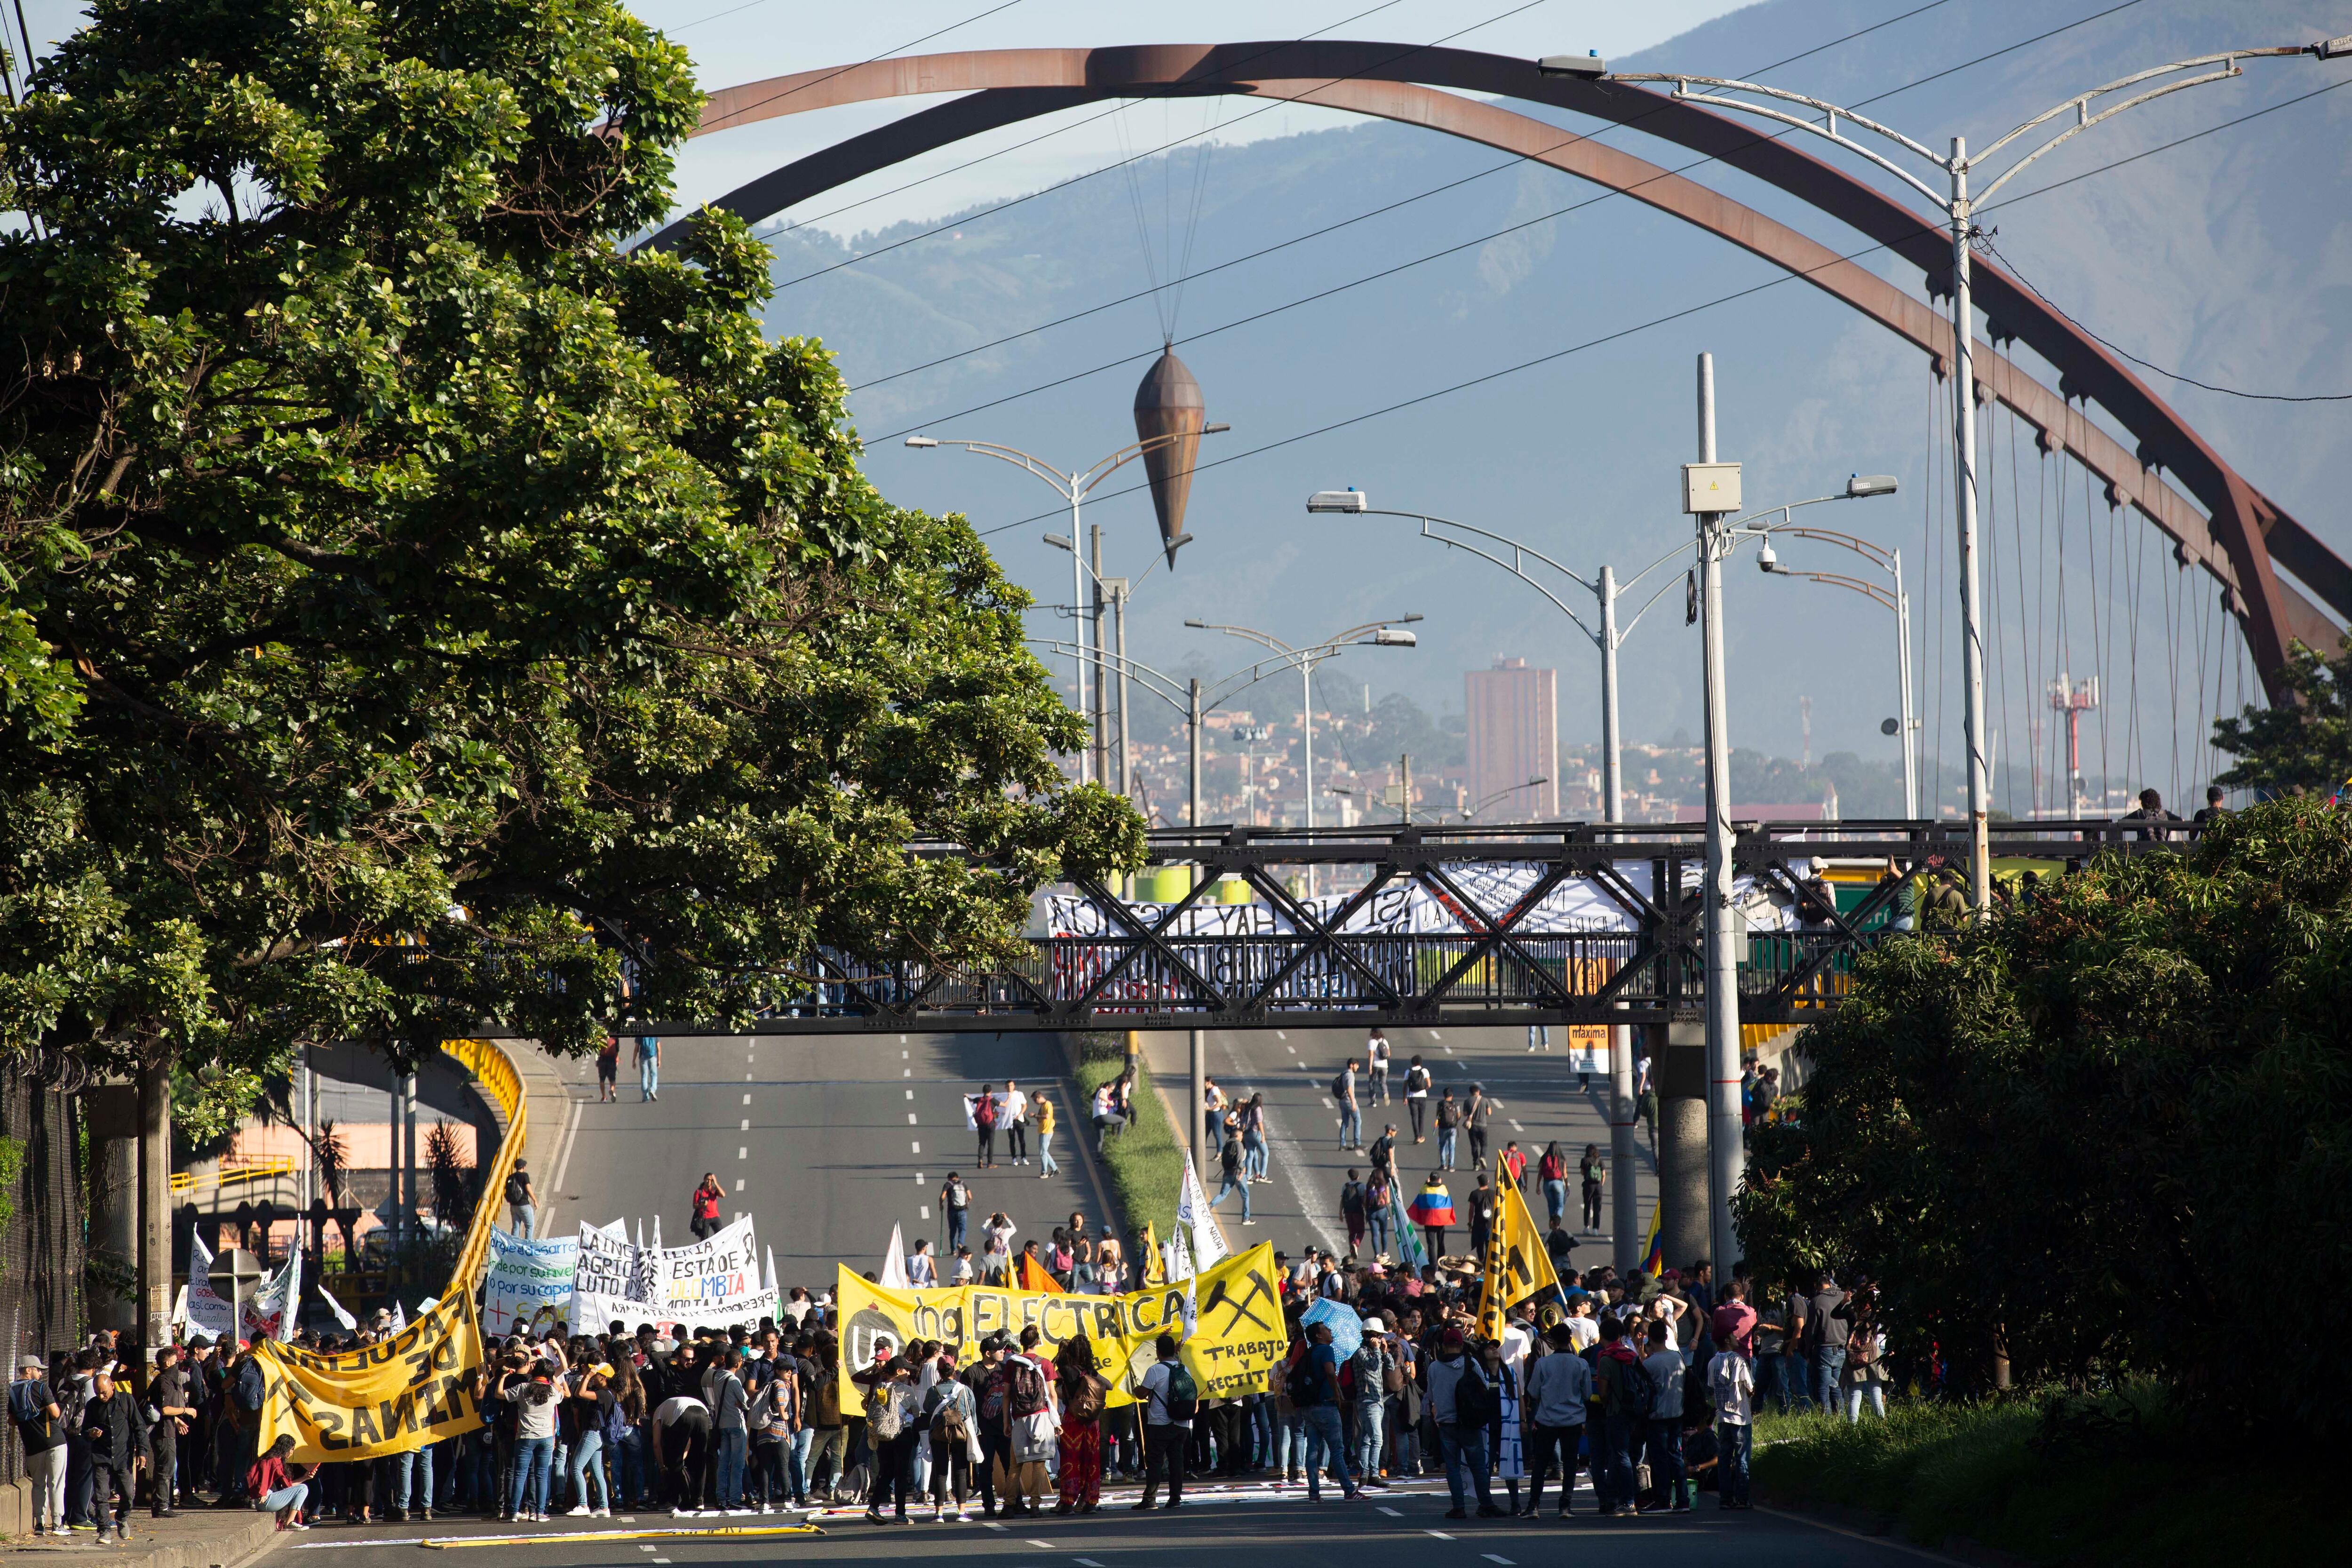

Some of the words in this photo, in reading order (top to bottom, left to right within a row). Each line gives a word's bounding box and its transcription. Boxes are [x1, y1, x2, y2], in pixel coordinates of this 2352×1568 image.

[1573, 1026, 1606, 1039] máxima
[1208, 1226, 1224, 1250] NADA
[509, 1265, 528, 1276] por
[498, 1280, 518, 1297] por
[520, 1284, 536, 1296] su
[575, 1273, 619, 1296] LUTO
[1202, 1340, 1285, 1361] TRABAJO
[1239, 1359, 1250, 1370] Y
[1206, 1369, 1272, 1393] RECTIT
